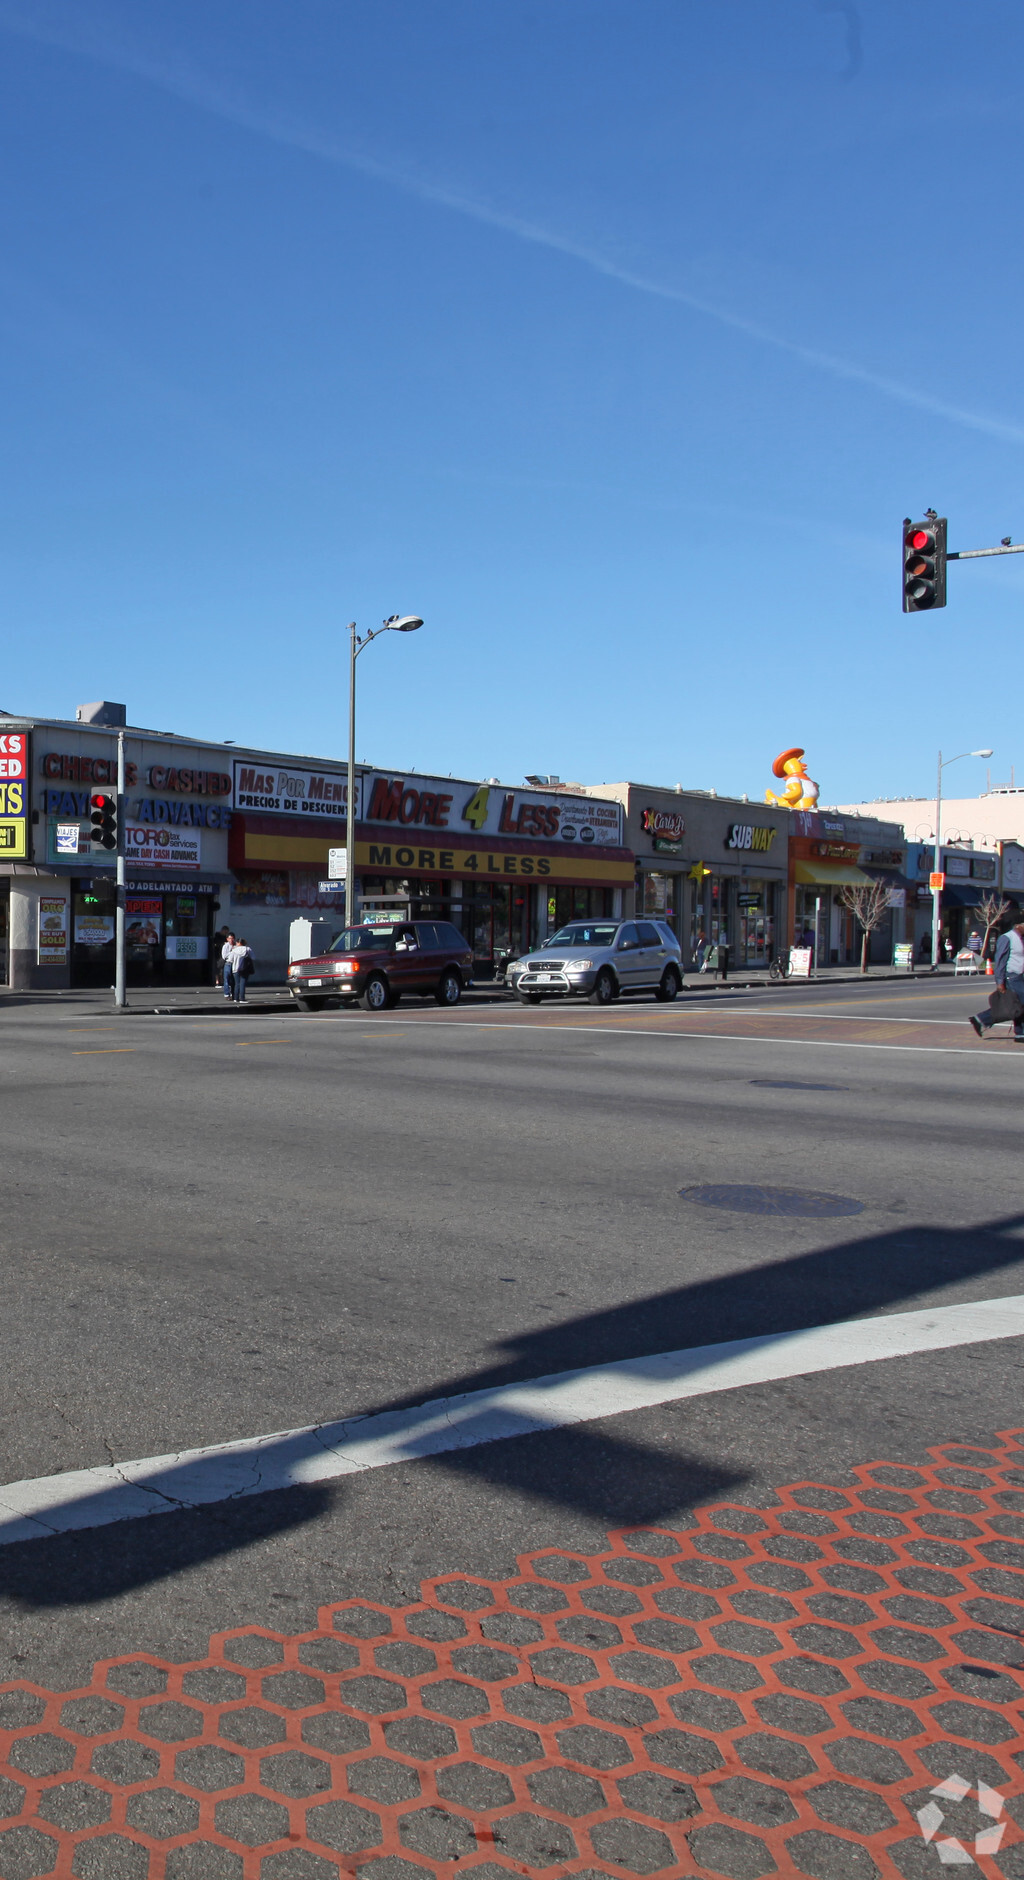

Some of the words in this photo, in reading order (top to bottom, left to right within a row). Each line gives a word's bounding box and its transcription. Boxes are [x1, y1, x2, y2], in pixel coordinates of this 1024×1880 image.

[149, 766, 232, 797] CASHED
[239, 768, 274, 794] MAS
[276, 772, 305, 798] POR
[239, 795, 280, 809] PRECIOS
[284, 799, 298, 810] DE
[368, 777, 454, 827] MORE
[464, 784, 490, 830] 4
[498, 794, 561, 838] LESS
[138, 799, 232, 829] ADVANCE
[57, 828, 77, 836] VIAJES
[126, 827, 170, 847] TORO
[729, 825, 776, 850] SUBWAY
[141, 849, 153, 859] DAY
[153, 849, 170, 860] CASH
[171, 850, 198, 861] ADVANCE
[369, 845, 454, 870] MORE
[464, 854, 478, 868] 4
[487, 855, 551, 875] LESS
[137, 882, 193, 892] ADELANTADO
[198, 884, 213, 893] ATM
[42, 904, 64, 913] ORO
[177, 943, 196, 951] PESOS
